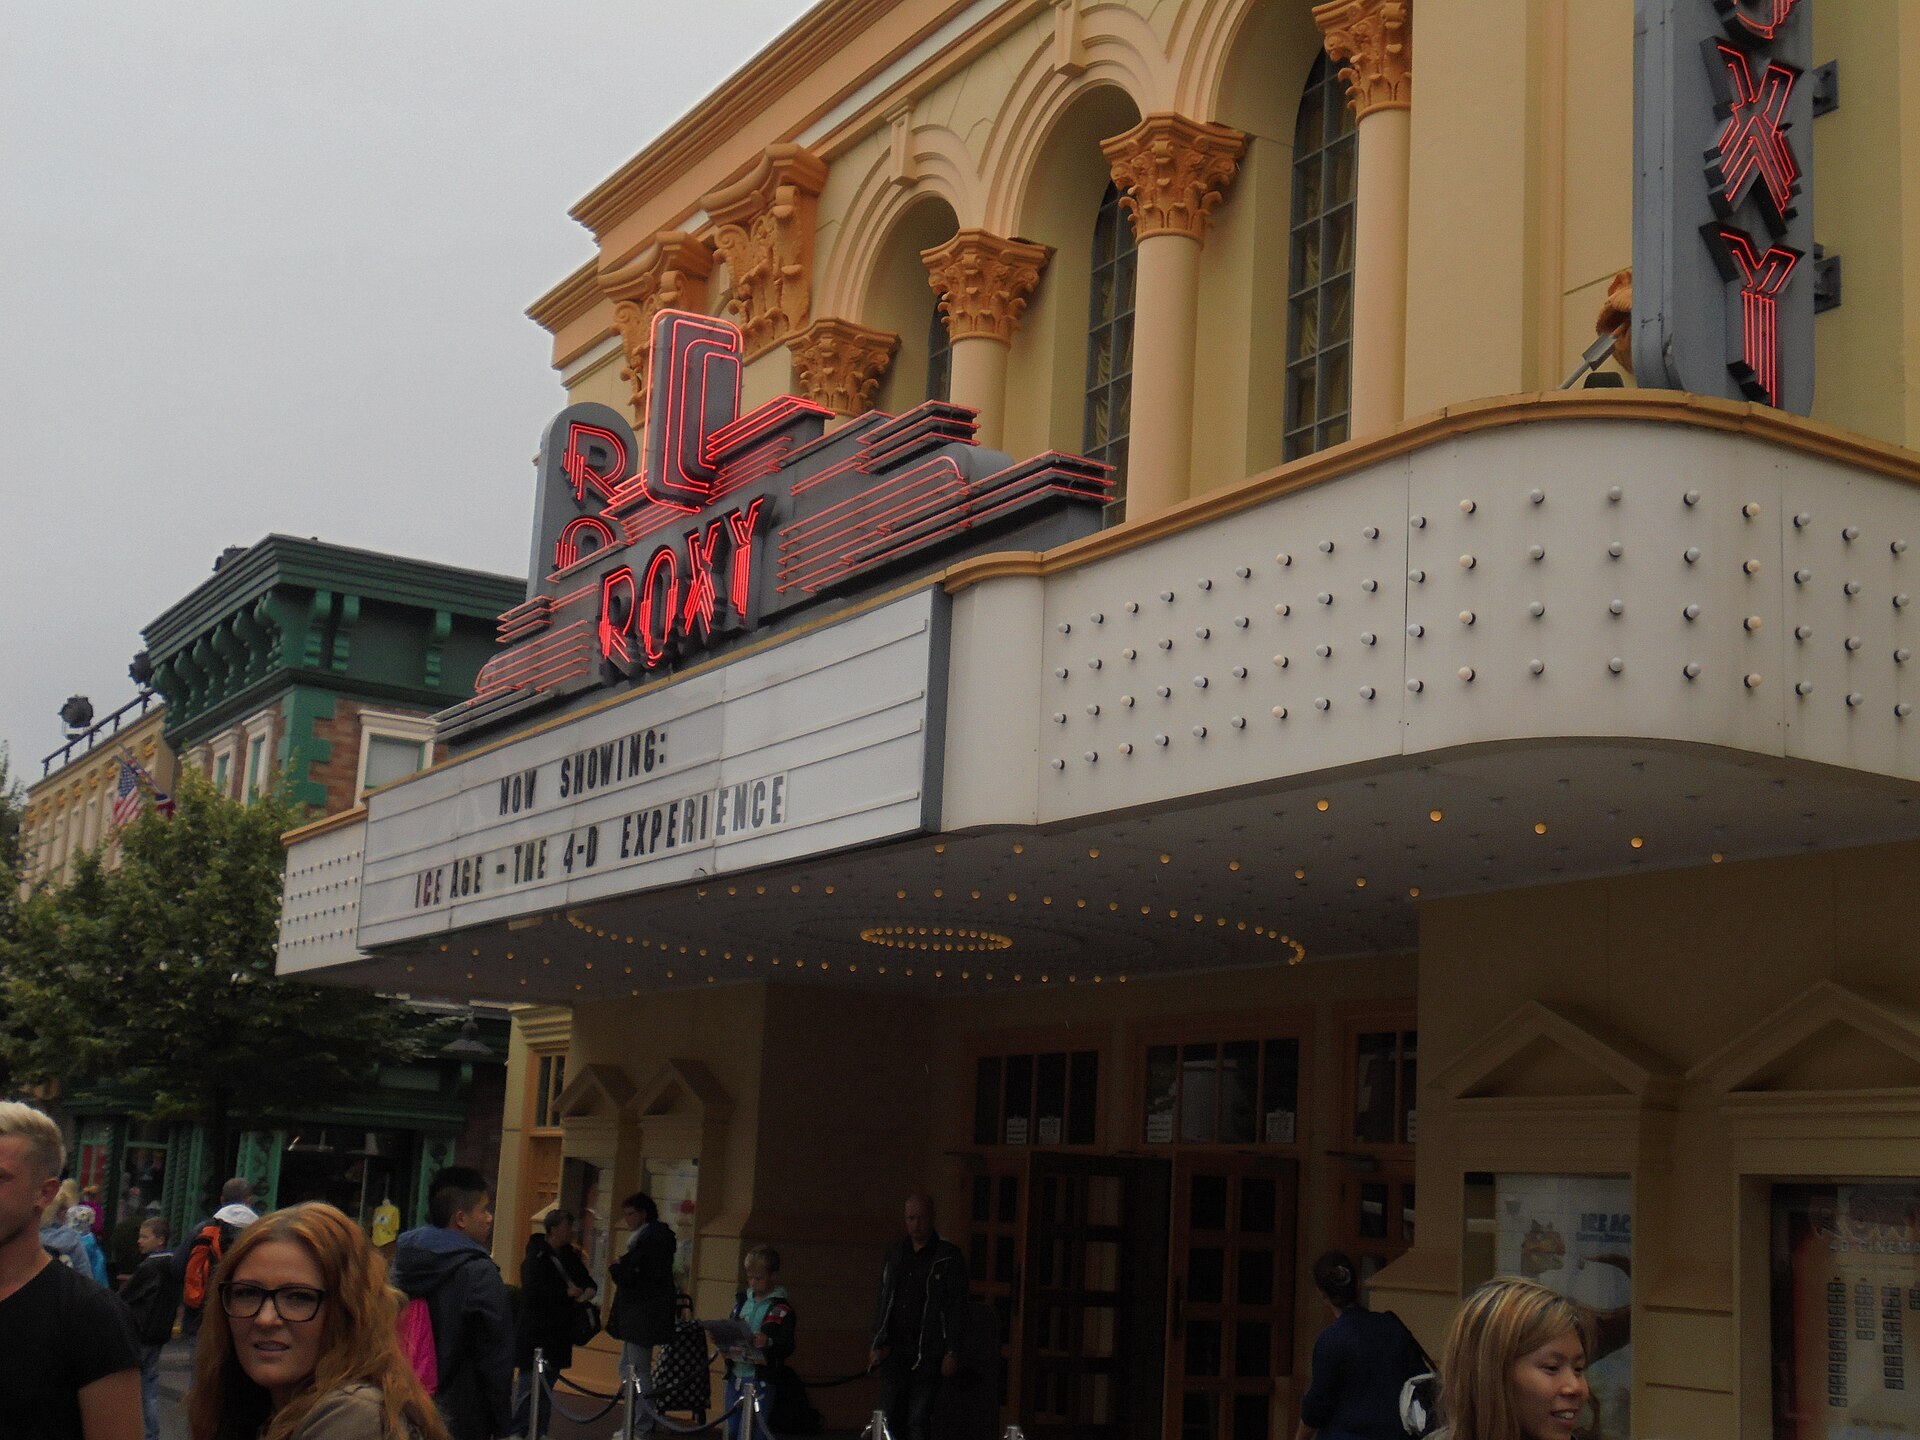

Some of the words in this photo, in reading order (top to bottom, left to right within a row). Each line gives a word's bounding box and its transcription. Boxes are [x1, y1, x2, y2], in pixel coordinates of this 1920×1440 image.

[597, 495, 770, 673] ROXY
[499, 769, 537, 816] NOW
[559, 729, 666, 798] SHOWING:
[414, 868, 443, 909] ICE
[449, 855, 483, 899] AGE
[514, 839, 547, 885] THE
[562, 825, 598, 874] 4-D
[619, 775, 784, 860] EXPERIENCE
